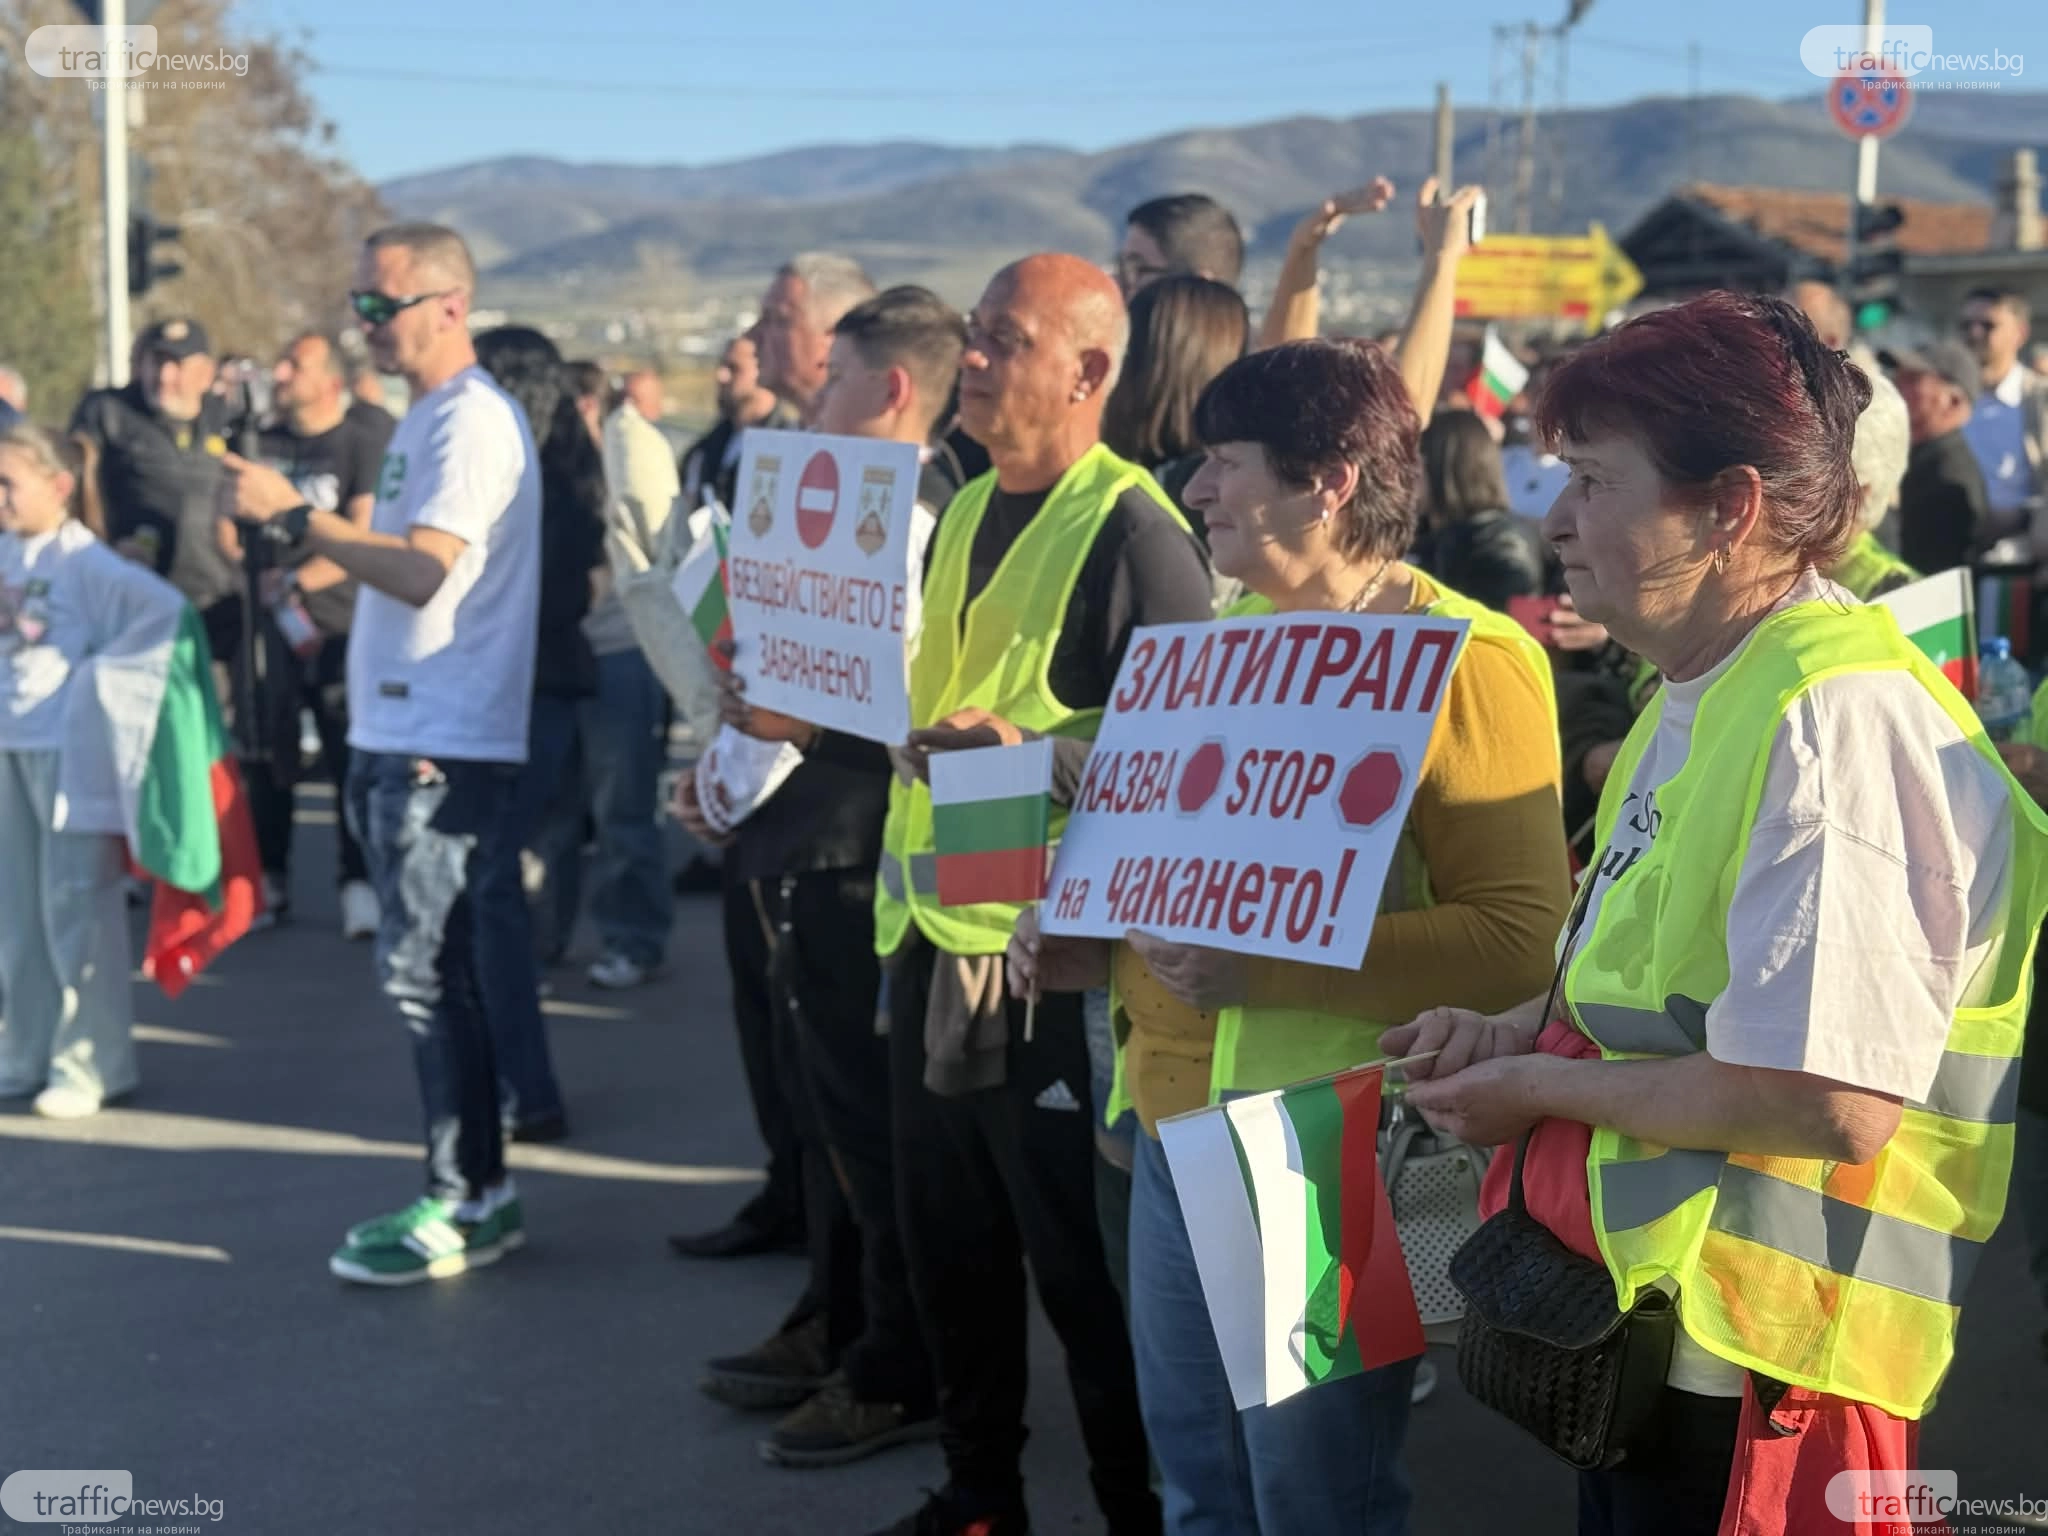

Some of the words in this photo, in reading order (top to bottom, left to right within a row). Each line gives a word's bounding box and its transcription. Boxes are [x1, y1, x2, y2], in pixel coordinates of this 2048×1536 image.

[733, 556, 885, 630] БЕЗДЕЙСТВИЕТО
[891, 584, 904, 632] Е
[760, 633, 872, 704] ЗАБРАНЕНО!
[1115, 625, 1459, 713] ЗЛАТИТРАП
[1077, 749, 1178, 815] КАЗВА
[1226, 748, 1335, 820] STOP
[1055, 877, 1090, 919] на
[1107, 848, 1358, 948] чакането!
